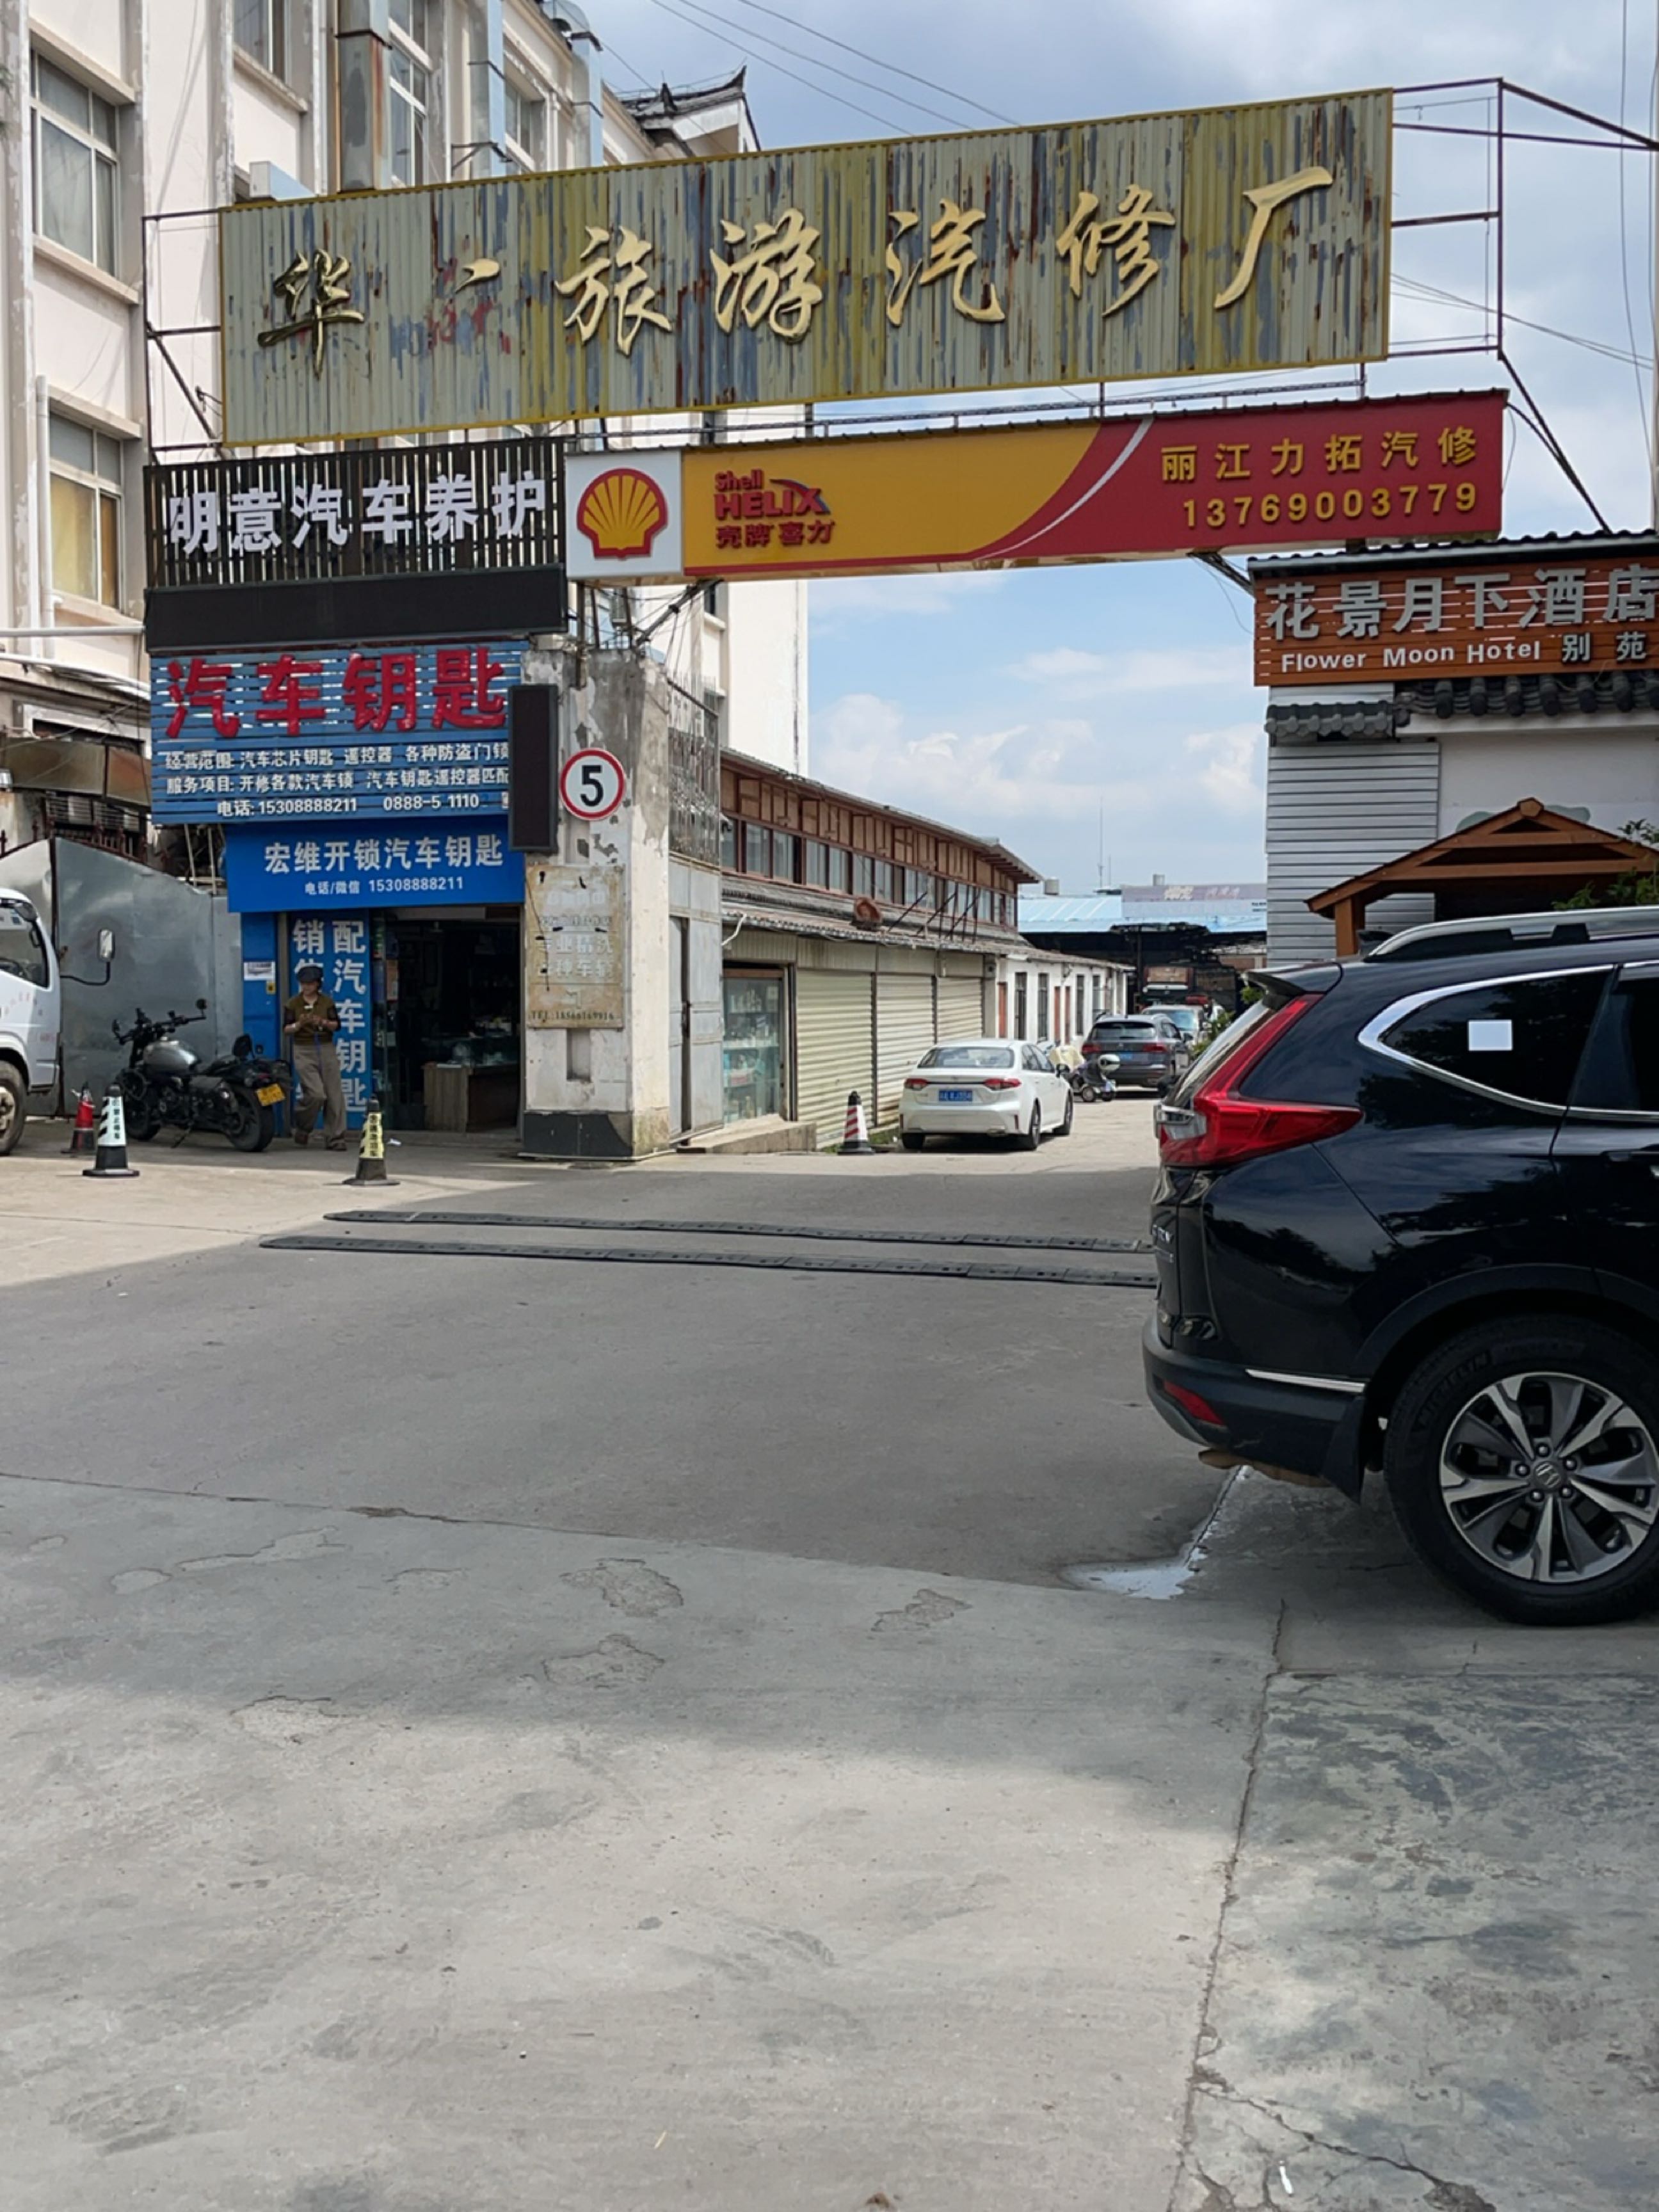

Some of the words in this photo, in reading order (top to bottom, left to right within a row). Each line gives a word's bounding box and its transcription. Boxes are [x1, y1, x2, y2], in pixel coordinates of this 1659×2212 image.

[257, 166, 1334, 378] 华旅游汽修厂
[1161, 426, 1476, 482] 丽江力拓汽修
[715, 469, 762, 490] Shell
[169, 470, 546, 555] 明意汽车养护
[715, 486, 830, 520] HELIX
[1183, 483, 1476, 528] 13769003779
[1265, 565, 1659, 640] 花景月下酒店
[1281, 652, 1366, 673] Flower
[1383, 645, 1454, 668] Moon
[1467, 641, 1541, 664] Hotel
[1562, 631, 1647, 663] 别苑
[166, 646, 509, 739] 汽车钥匙
[580, 765, 604, 807] 5
[264, 834, 503, 874] 宏维开锁汽车钥匙
[369, 877, 463, 892] 15308888211
